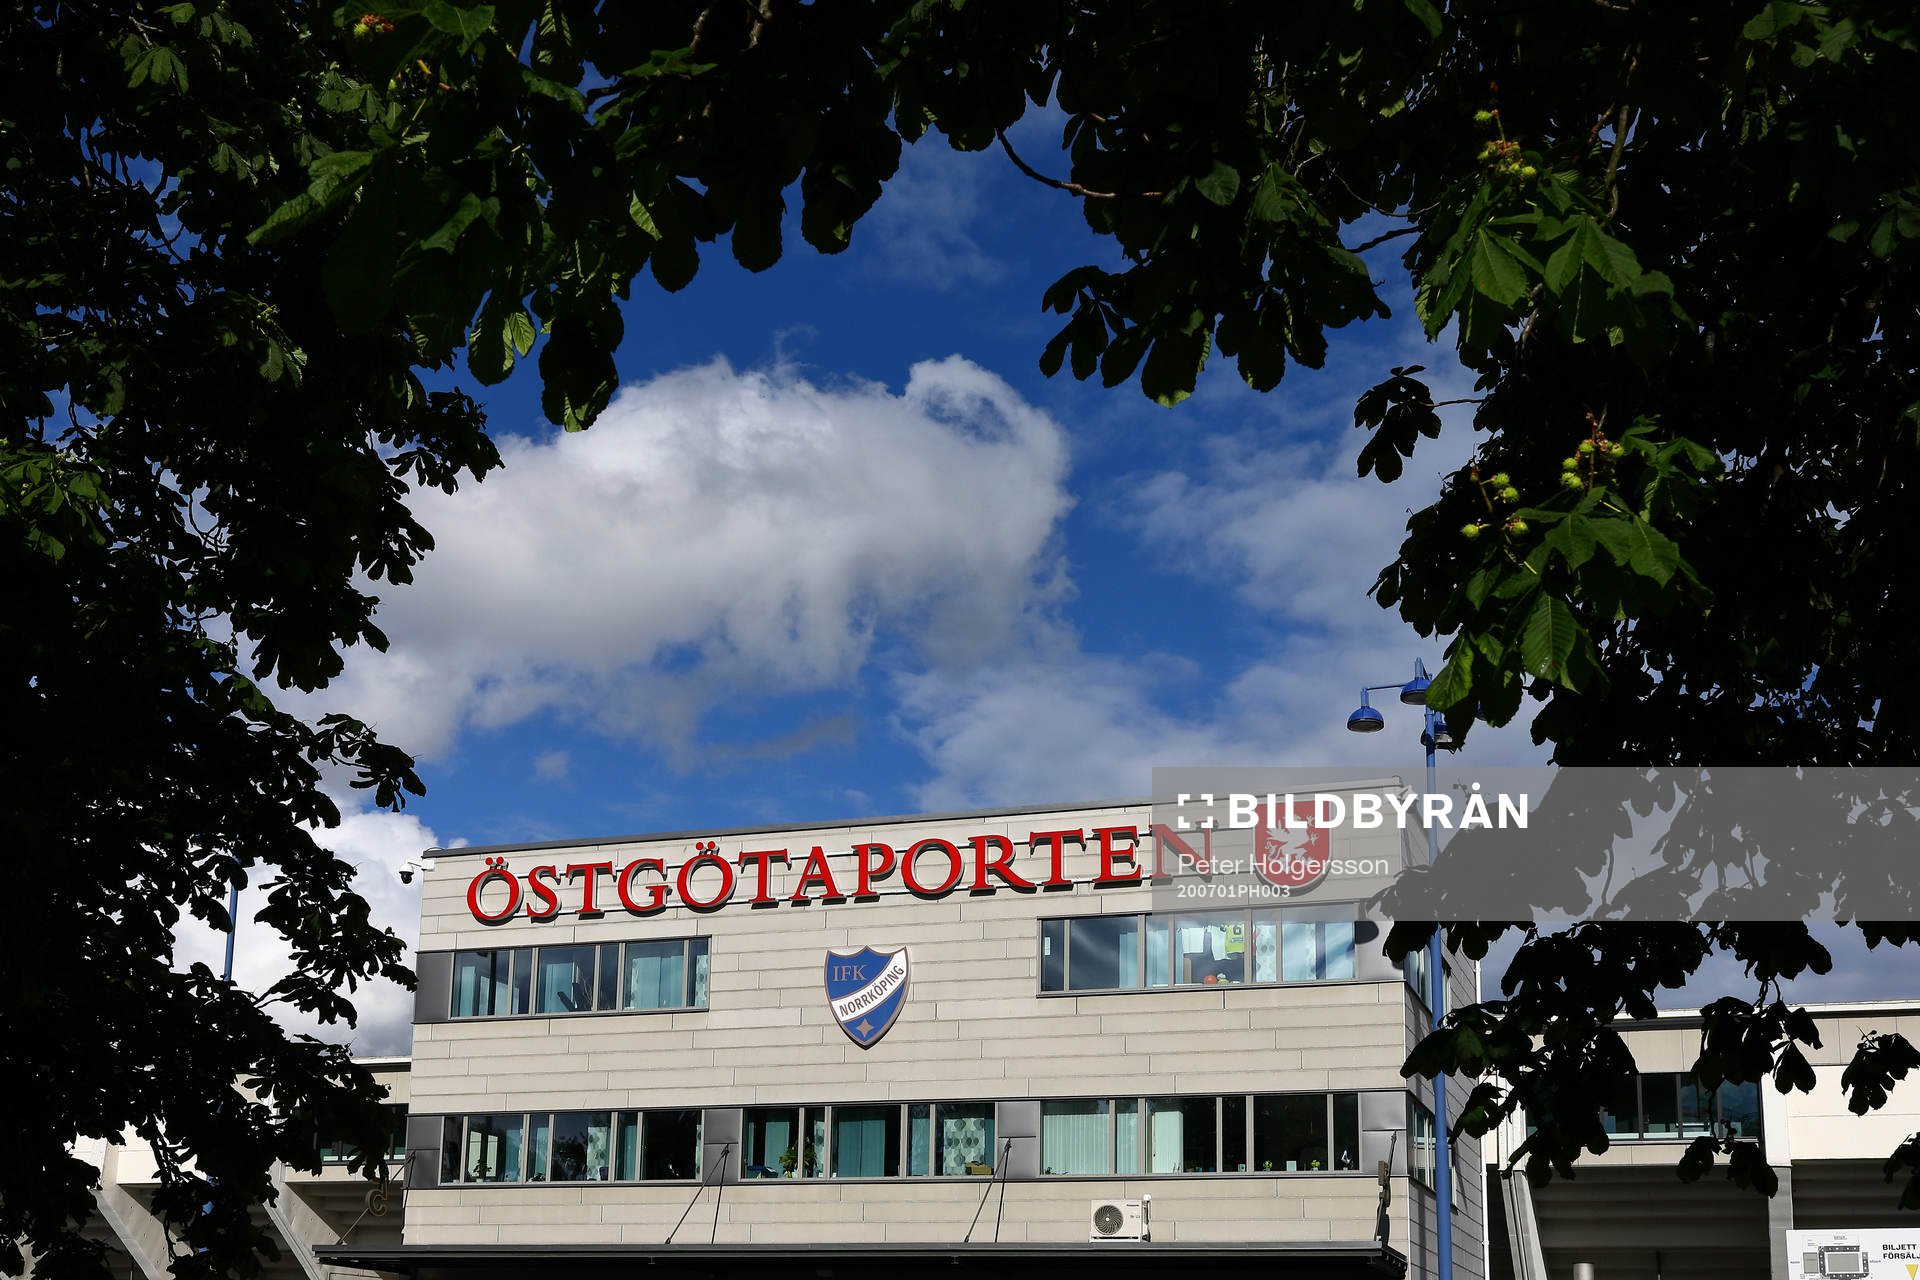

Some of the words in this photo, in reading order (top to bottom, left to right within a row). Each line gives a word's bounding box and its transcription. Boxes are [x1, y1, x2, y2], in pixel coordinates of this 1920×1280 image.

[466, 819, 1218, 923] ÖSTGÖTAPORTEN
[832, 964, 868, 982] IFK
[839, 965, 904, 1017] NORRKÖPING
